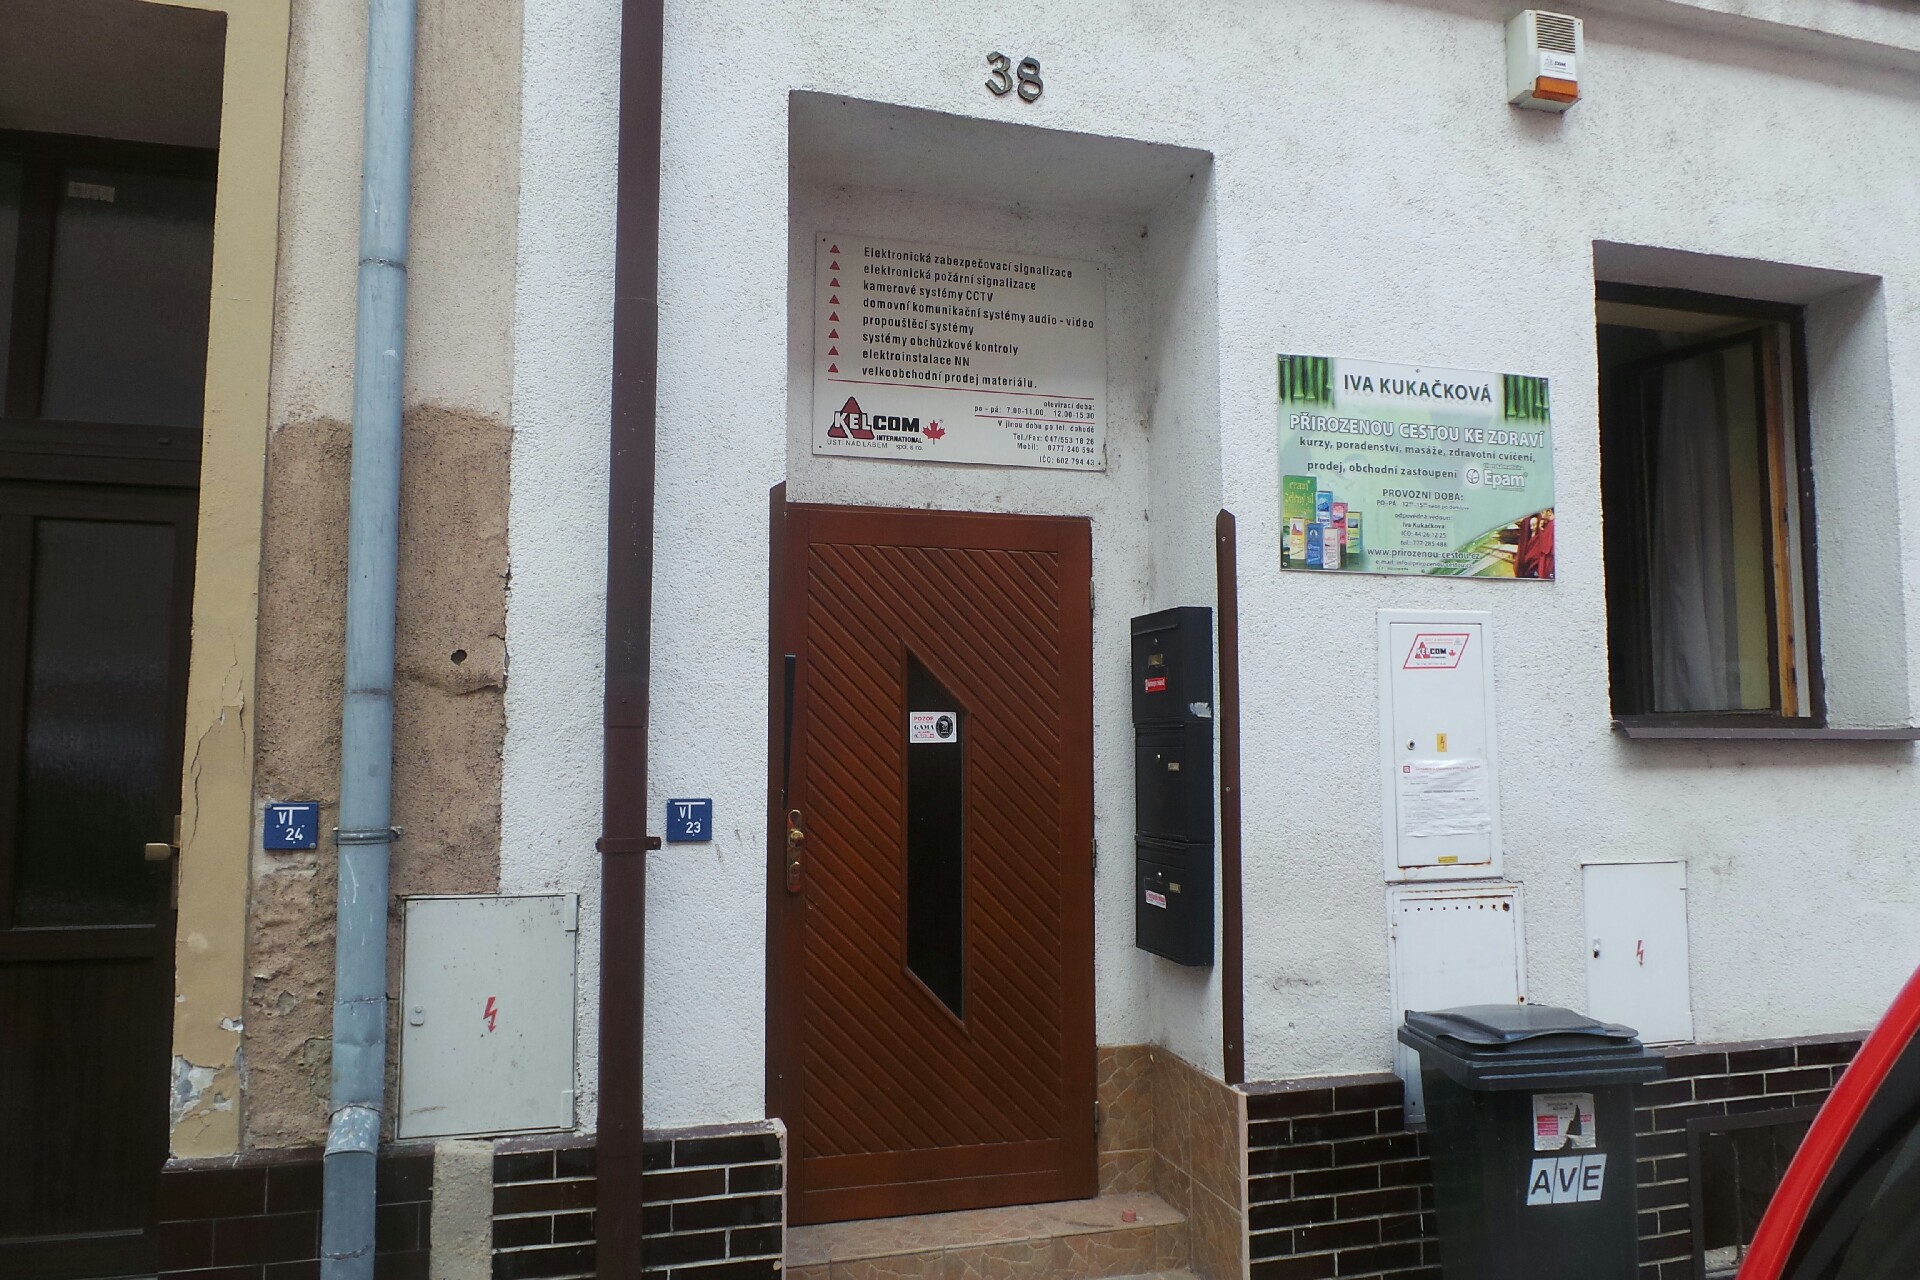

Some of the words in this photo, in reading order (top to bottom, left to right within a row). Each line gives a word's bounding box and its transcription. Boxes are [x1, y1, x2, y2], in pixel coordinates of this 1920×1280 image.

[985, 51, 1044, 104] 38
[864, 246, 931, 263] Elektronická
[934, 255, 1012, 271] zabezpečovací
[1014, 262, 1073, 279] signalizace
[863, 264, 931, 280] elektronická
[934, 271, 974, 284] požární
[976, 275, 1036, 290] signalizace
[863, 280, 916, 295] kamerové
[919, 287, 963, 301] systémy
[966, 289, 994, 302] CCTV
[863, 298, 910, 311] domovní
[912, 301, 981, 318] komunikační
[983, 309, 1026, 324] systémy
[1028, 314, 1057, 325] audio
[1066, 317, 1094, 328] video
[863, 316, 928, 330] propouštěcí
[930, 322, 974, 336] systémy
[862, 333, 907, 347] systémy
[910, 336, 973, 351] obchůzkové
[975, 341, 1019, 356] kontroly
[862, 349, 952, 365] elektroinstalace
[954, 355, 970, 367] NN
[862, 366, 942, 380] velkoobchodní
[944, 373, 979, 386] prodej
[982, 375, 1037, 388] materiálu.
[1344, 374, 1374, 392] IVA
[1380, 377, 1492, 402] KUKAČKOVÁ
[834, 411, 920, 438] KELCOM
[1289, 412, 1394, 437] PŘIROZENOU
[1399, 422, 1459, 442] CESTOU
[1464, 428, 1483, 443] KE
[1487, 430, 1545, 448] ZDRAVÍ
[845, 439, 861, 447] NAD
[862, 440, 888, 449] LABEM
[876, 434, 923, 444] INTERNATIONAL
[1299, 436, 1333, 449] kurzy,
[1336, 440, 1402, 454] poradenství,
[1404, 445, 1446, 457] masáže,
[1307, 461, 1346, 473] prodej,
[1349, 463, 1398, 475] obchodní
[1382, 488, 1431, 500] PROVOZNÍ
[1434, 491, 1464, 501] DOBA:
[285, 827, 304, 841] 24
[685, 821, 701, 834] 23
[1530, 1164, 1602, 1195] AVE
